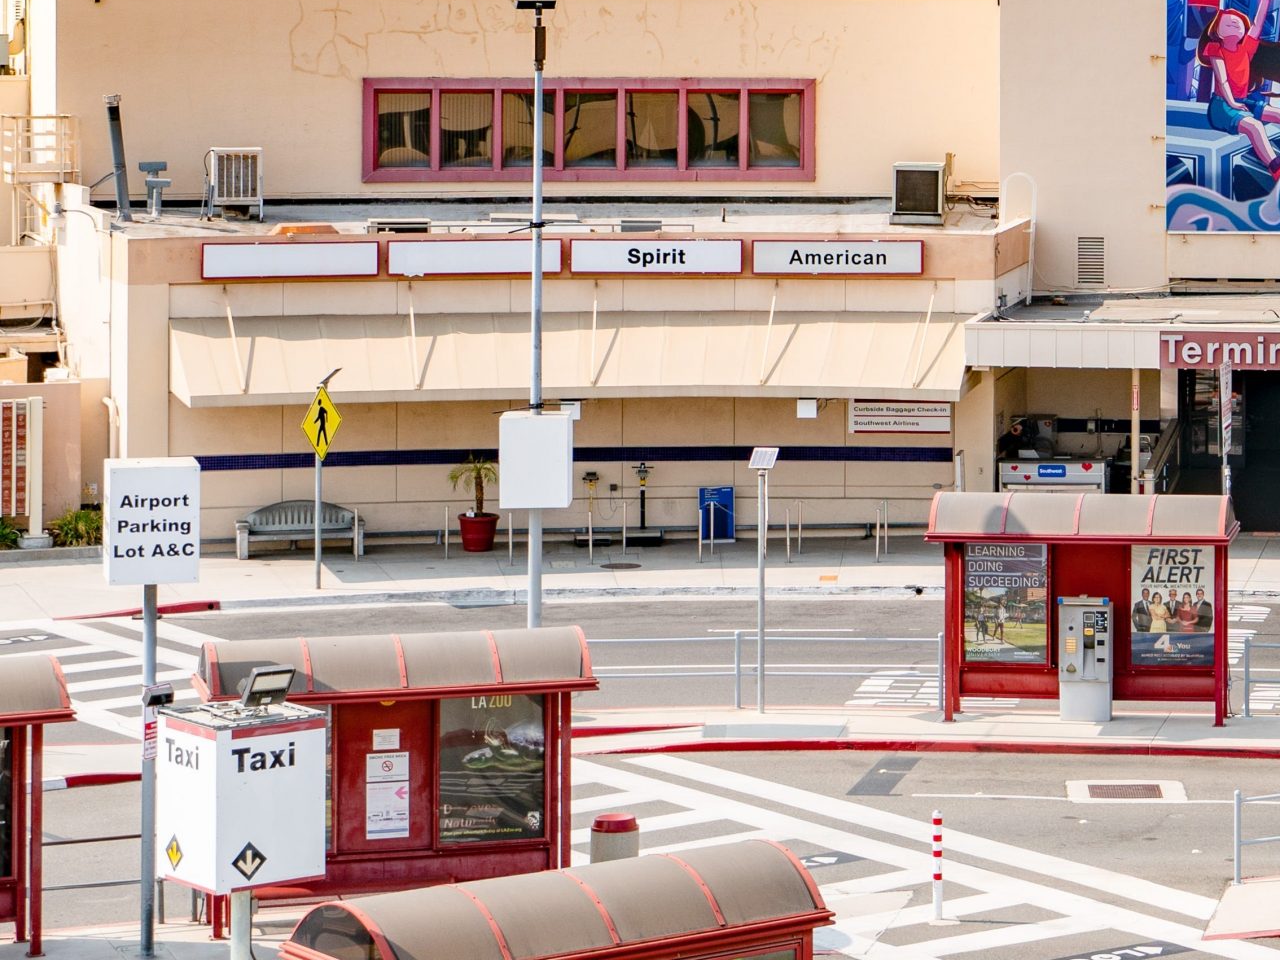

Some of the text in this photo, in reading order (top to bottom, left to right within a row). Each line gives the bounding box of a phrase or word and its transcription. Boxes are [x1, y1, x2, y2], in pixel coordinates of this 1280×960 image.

[627, 248, 686, 267] Spirit
[789, 249, 888, 266] American
[885, 406, 916, 414] Baggage
[120, 493, 190, 511] Airport
[117, 519, 191, 535] Parking
[113, 542, 195, 558] Lot A&C
[968, 546, 1025, 557] LEARNING
[1146, 548, 1203, 566] FIRST
[968, 561, 1004, 572] DOING
[968, 576, 1040, 587] SUCCEEDING
[1140, 566, 1205, 584] ALERT
[471, 694, 512, 709] LA ZOO
[165, 737, 199, 770] Taxi
[231, 741, 295, 773] Taxi
